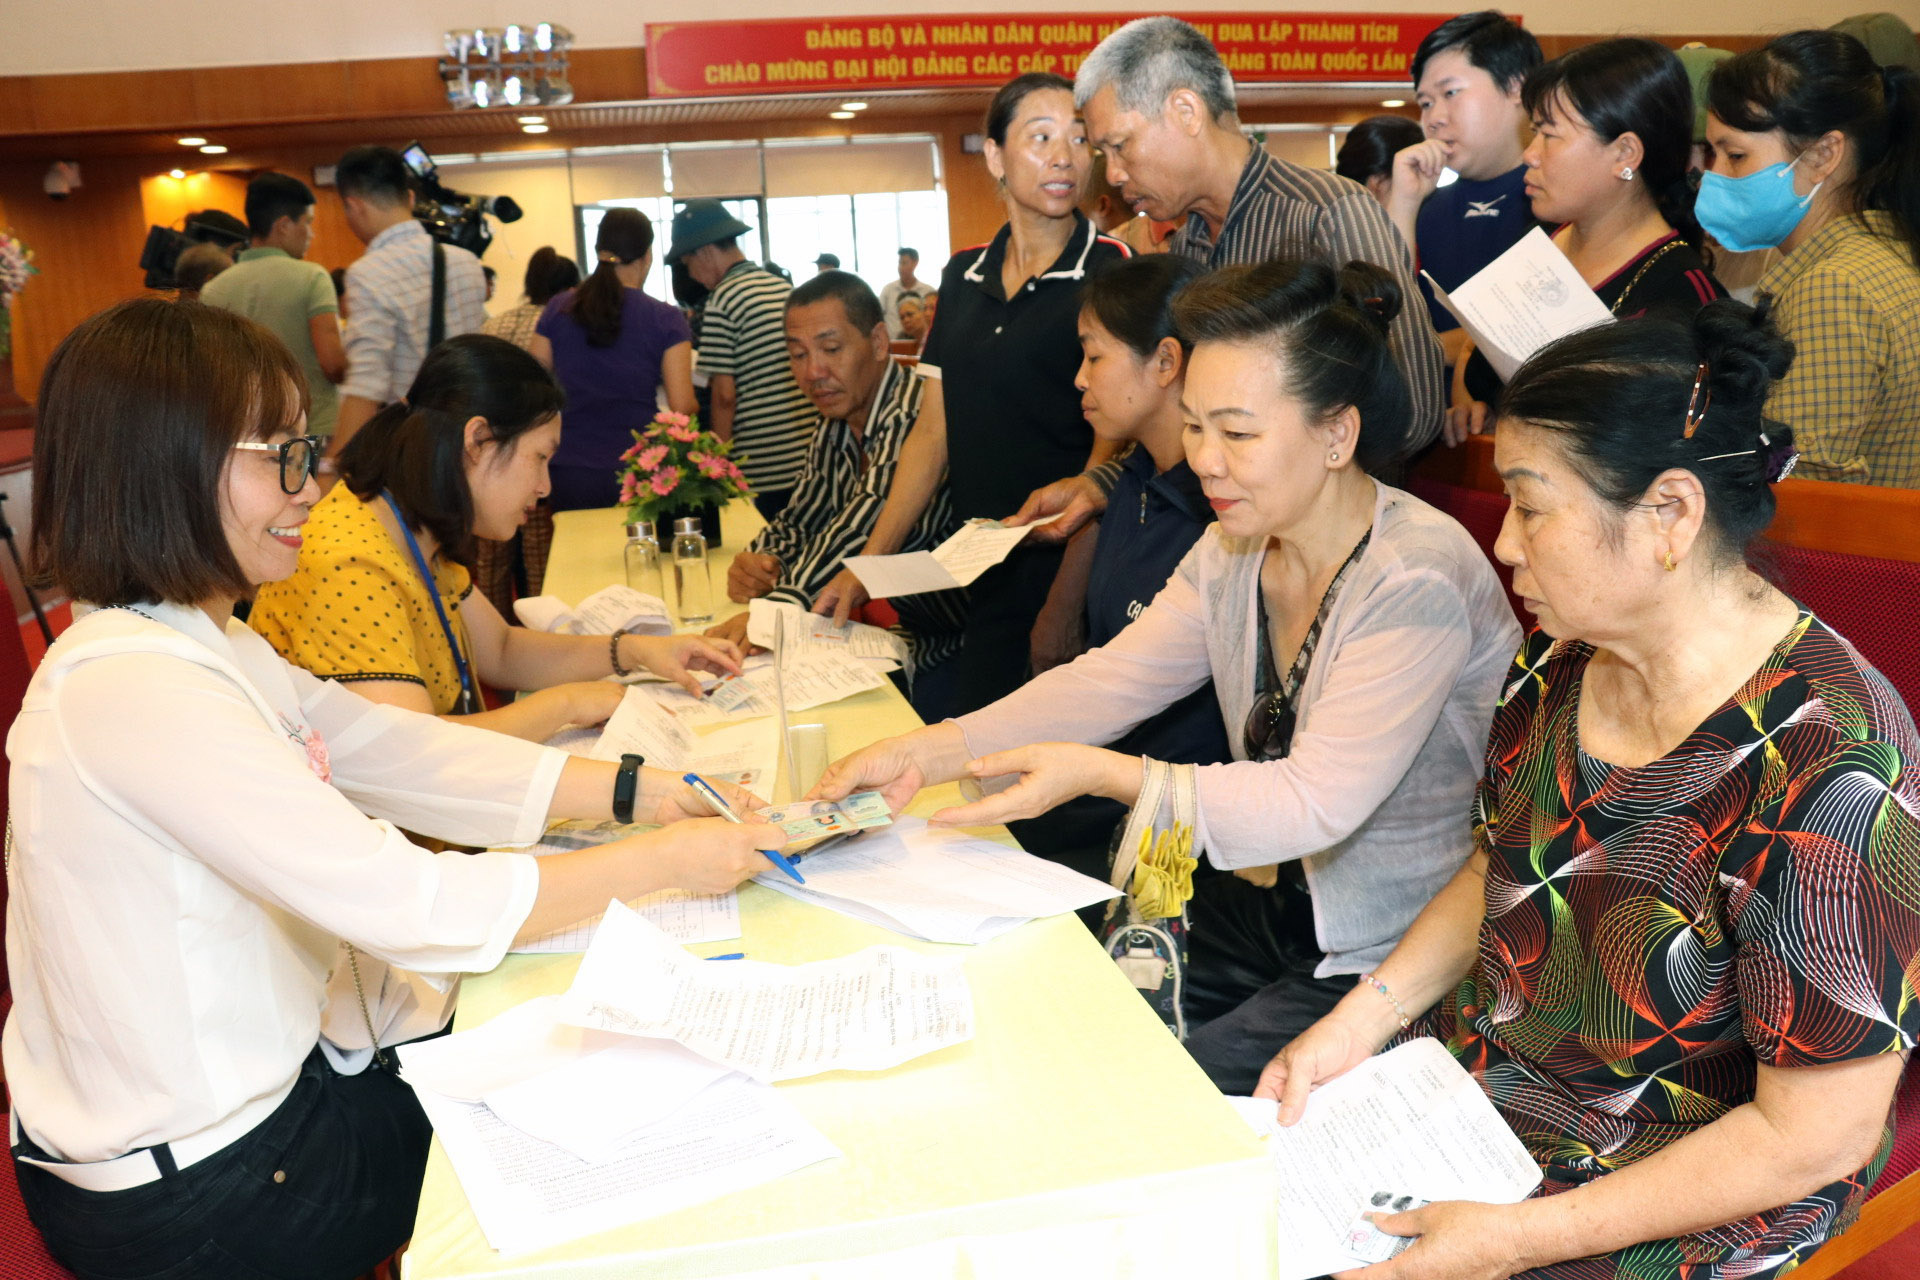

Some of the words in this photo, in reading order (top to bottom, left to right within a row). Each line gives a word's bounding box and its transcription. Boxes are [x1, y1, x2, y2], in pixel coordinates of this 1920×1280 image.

[805, 24, 863, 49] ĐẢNG
[868, 23, 895, 50] BỘ
[901, 22, 927, 46] VÀ
[932, 21, 988, 45] NHÂN
[993, 21, 1034, 44] DÂN
[1039, 21, 1092, 47] QUẬN
[1217, 23, 1254, 43] ĐUA
[1259, 20, 1293, 45] LẬP
[1298, 21, 1355, 42] THÀNH
[1360, 21, 1399, 42] TÍCH
[705, 61, 760, 84] CHÀO
[766, 58, 828, 82] MỪNG
[833, 58, 868, 82] ĐẠI
[873, 54, 907, 81] HỘI
[912, 51, 968, 76] ĐẢNG
[972, 51, 1012, 75] CÁC
[1017, 49, 1057, 73] CẤP
[1271, 48, 1317, 70] TOÀN
[1322, 47, 1369, 72] QUỐC
